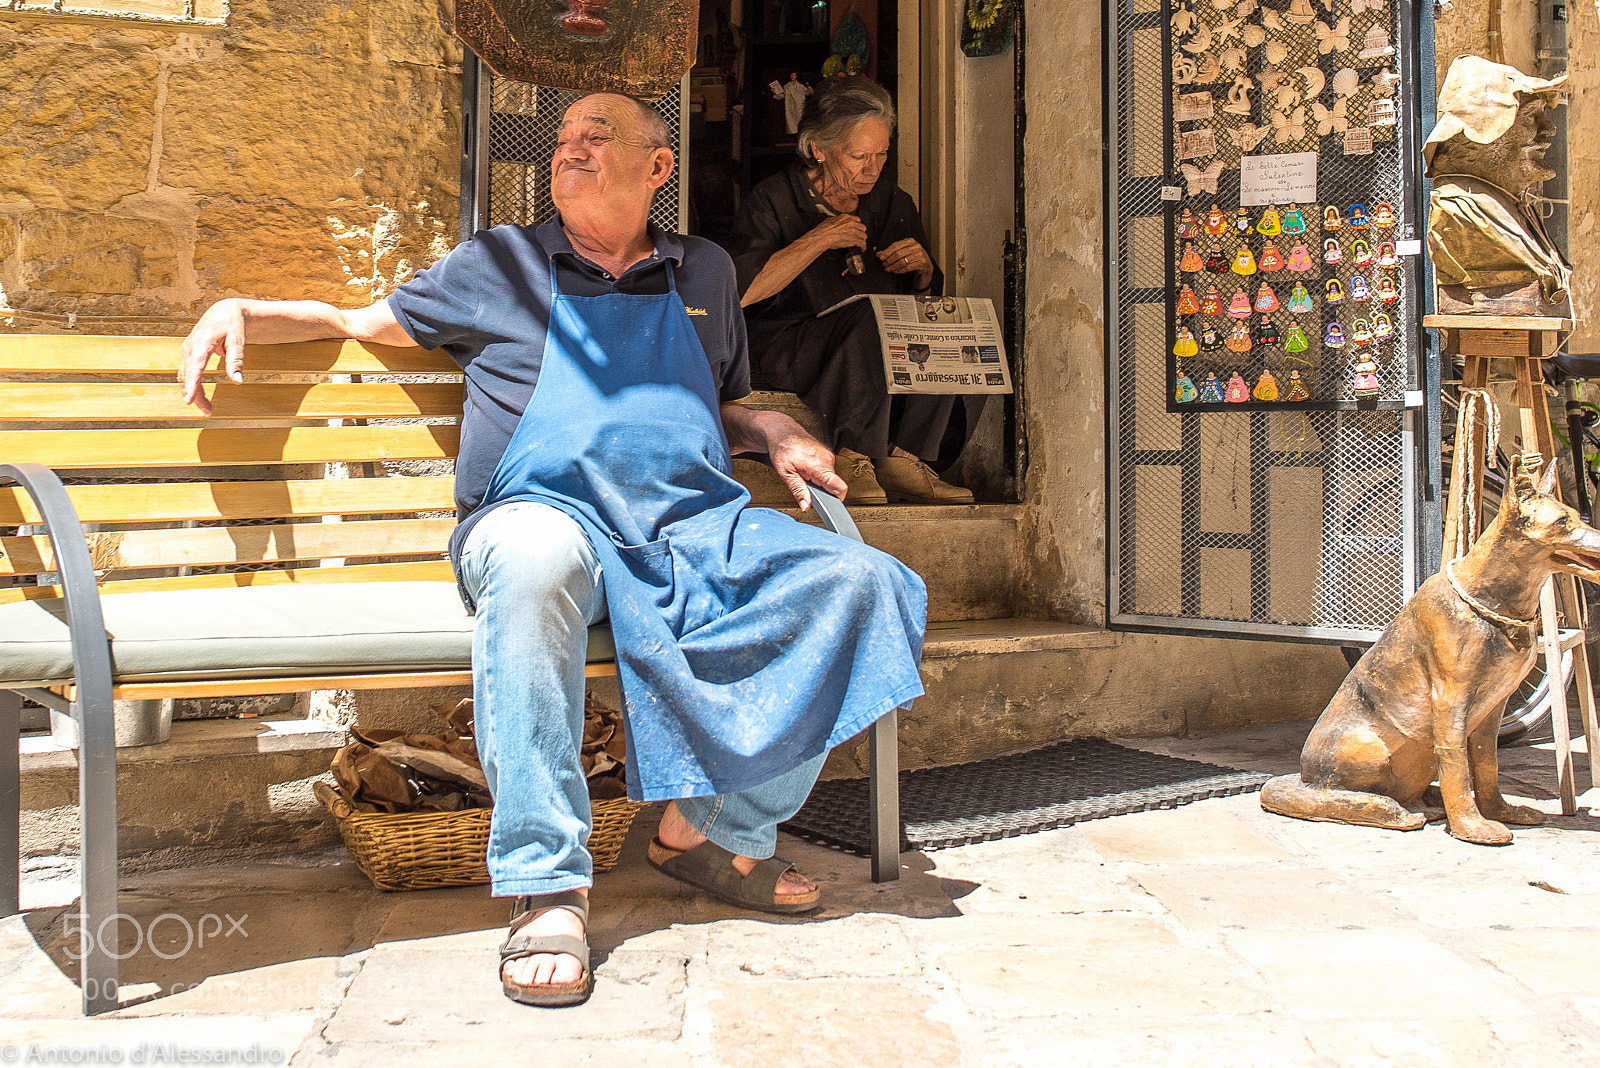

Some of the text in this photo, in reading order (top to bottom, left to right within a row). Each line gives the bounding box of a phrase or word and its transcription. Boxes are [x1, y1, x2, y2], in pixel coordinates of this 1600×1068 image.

[903, 333, 919, 342] Colle
[919, 334, 924, 342] il
[951, 334, 977, 342] Incarico
[915, 372, 983, 385] Il Messaggero
